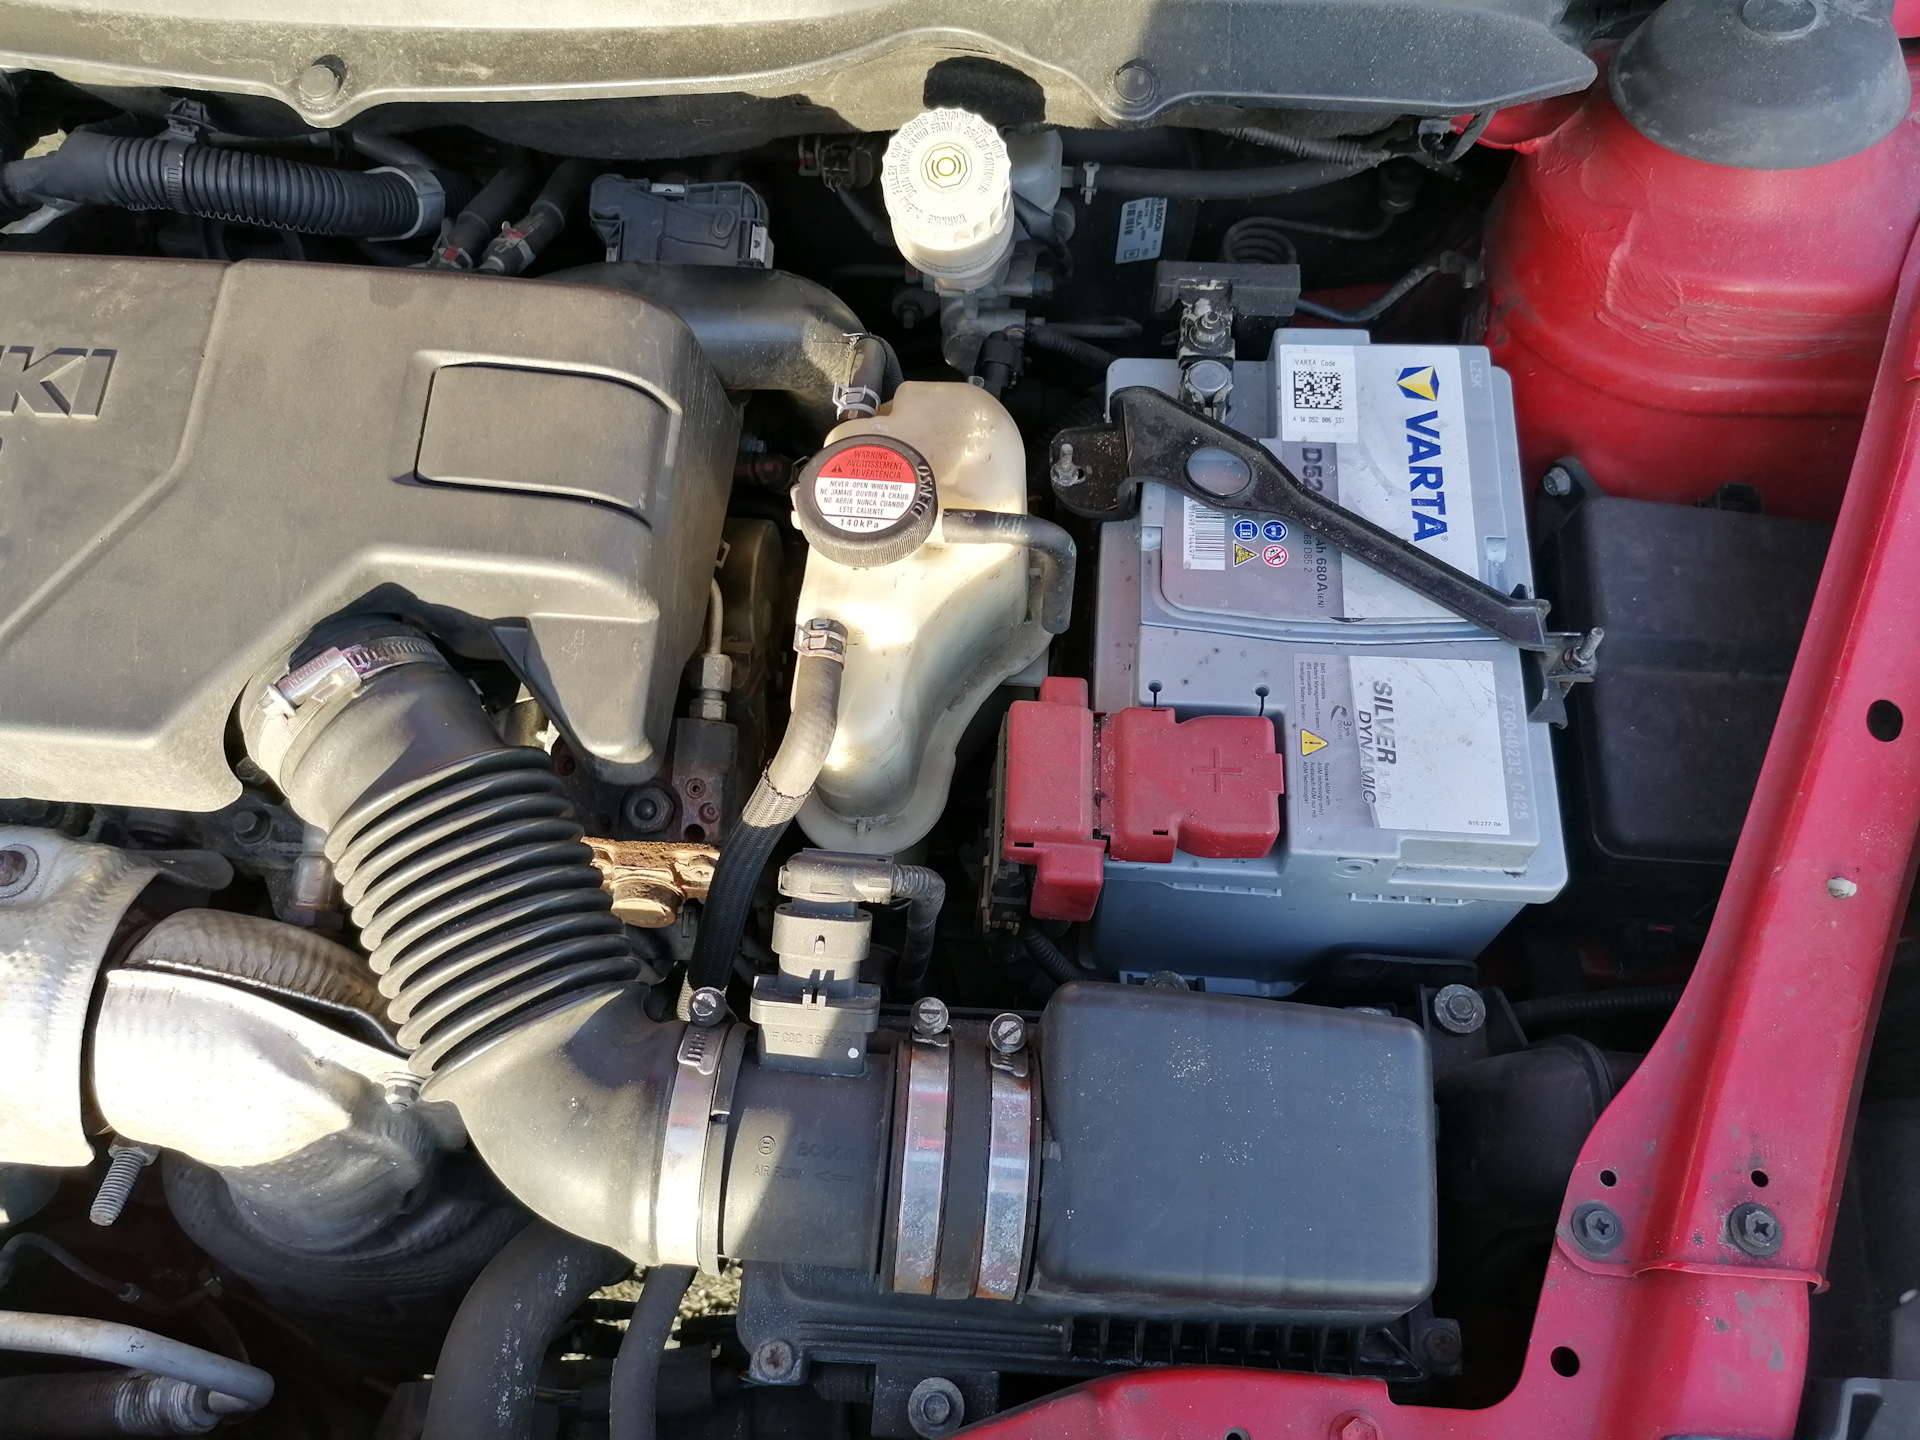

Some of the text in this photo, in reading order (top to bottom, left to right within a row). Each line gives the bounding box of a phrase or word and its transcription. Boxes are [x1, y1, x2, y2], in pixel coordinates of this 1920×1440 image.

[1154, 207, 1164, 232] BOSCH
[0, 345, 117, 420] KI
[854, 450, 888, 460] WARNING
[846, 460, 904, 470] AVERTISSEMENT
[1302, 448, 1323, 492] D52
[850, 469, 901, 479] ADVERTENCIA
[1406, 409, 1447, 542] VARTA
[830, 480, 849, 488] NEVER
[852, 481, 868, 489] OPEN
[911, 462, 933, 519] DENSO
[856, 490, 878, 498] OUVRIR
[835, 497, 853, 505] ABRIR
[856, 499, 877, 507] NUNCA
[879, 500, 904, 509] CUANDO
[839, 506, 853, 514] ESTE
[840, 518, 879, 529] 140kPa
[1304, 532, 1312, 545] 68
[1303, 547, 1313, 565] D85
[1373, 681, 1397, 764] SILVER
[1359, 710, 1376, 804] DYNAMIC
[1511, 783, 1530, 820] 0425
[753, 1163, 770, 1177] AIR
